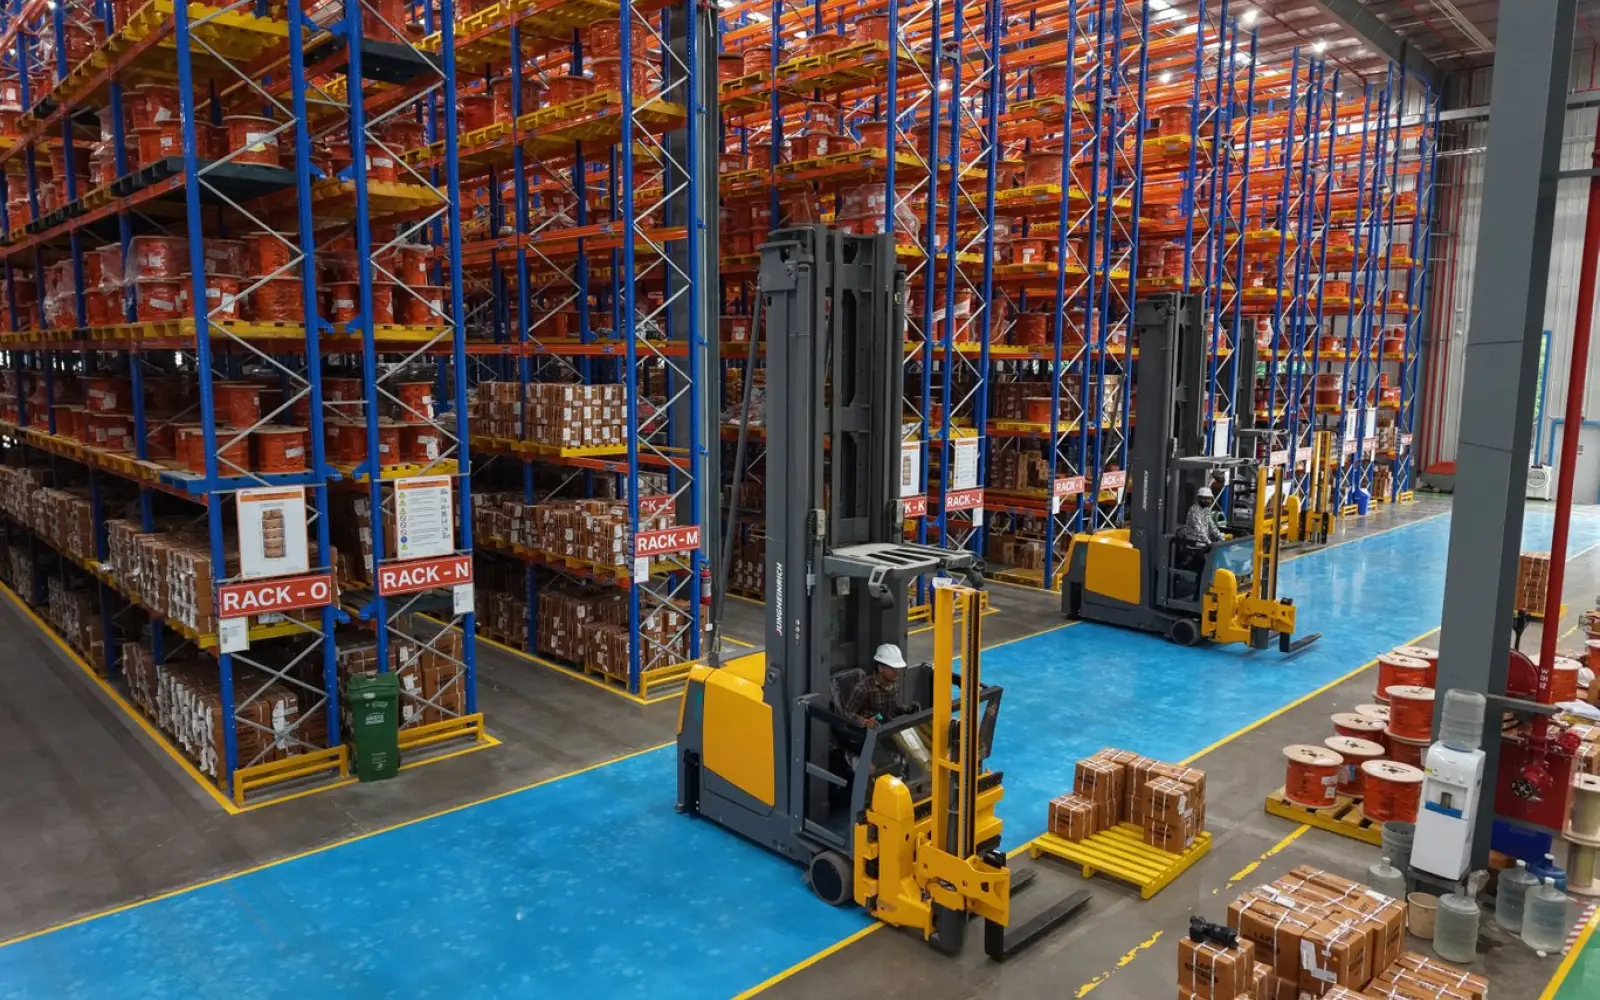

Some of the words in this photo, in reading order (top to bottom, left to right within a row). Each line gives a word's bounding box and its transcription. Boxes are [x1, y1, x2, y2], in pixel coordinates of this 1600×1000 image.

[917, 500, 925, 512] K
[947, 494, 971, 508] RACK
[976, 493, 982, 504] J
[637, 534, 677, 552] RACK
[686, 531, 698, 545] M
[382, 566, 439, 589] RACK
[455, 561, 469, 578] N
[223, 585, 292, 611] RACK
[310, 582, 328, 600] O
[775, 562, 784, 637] JUNGHEINRICH
